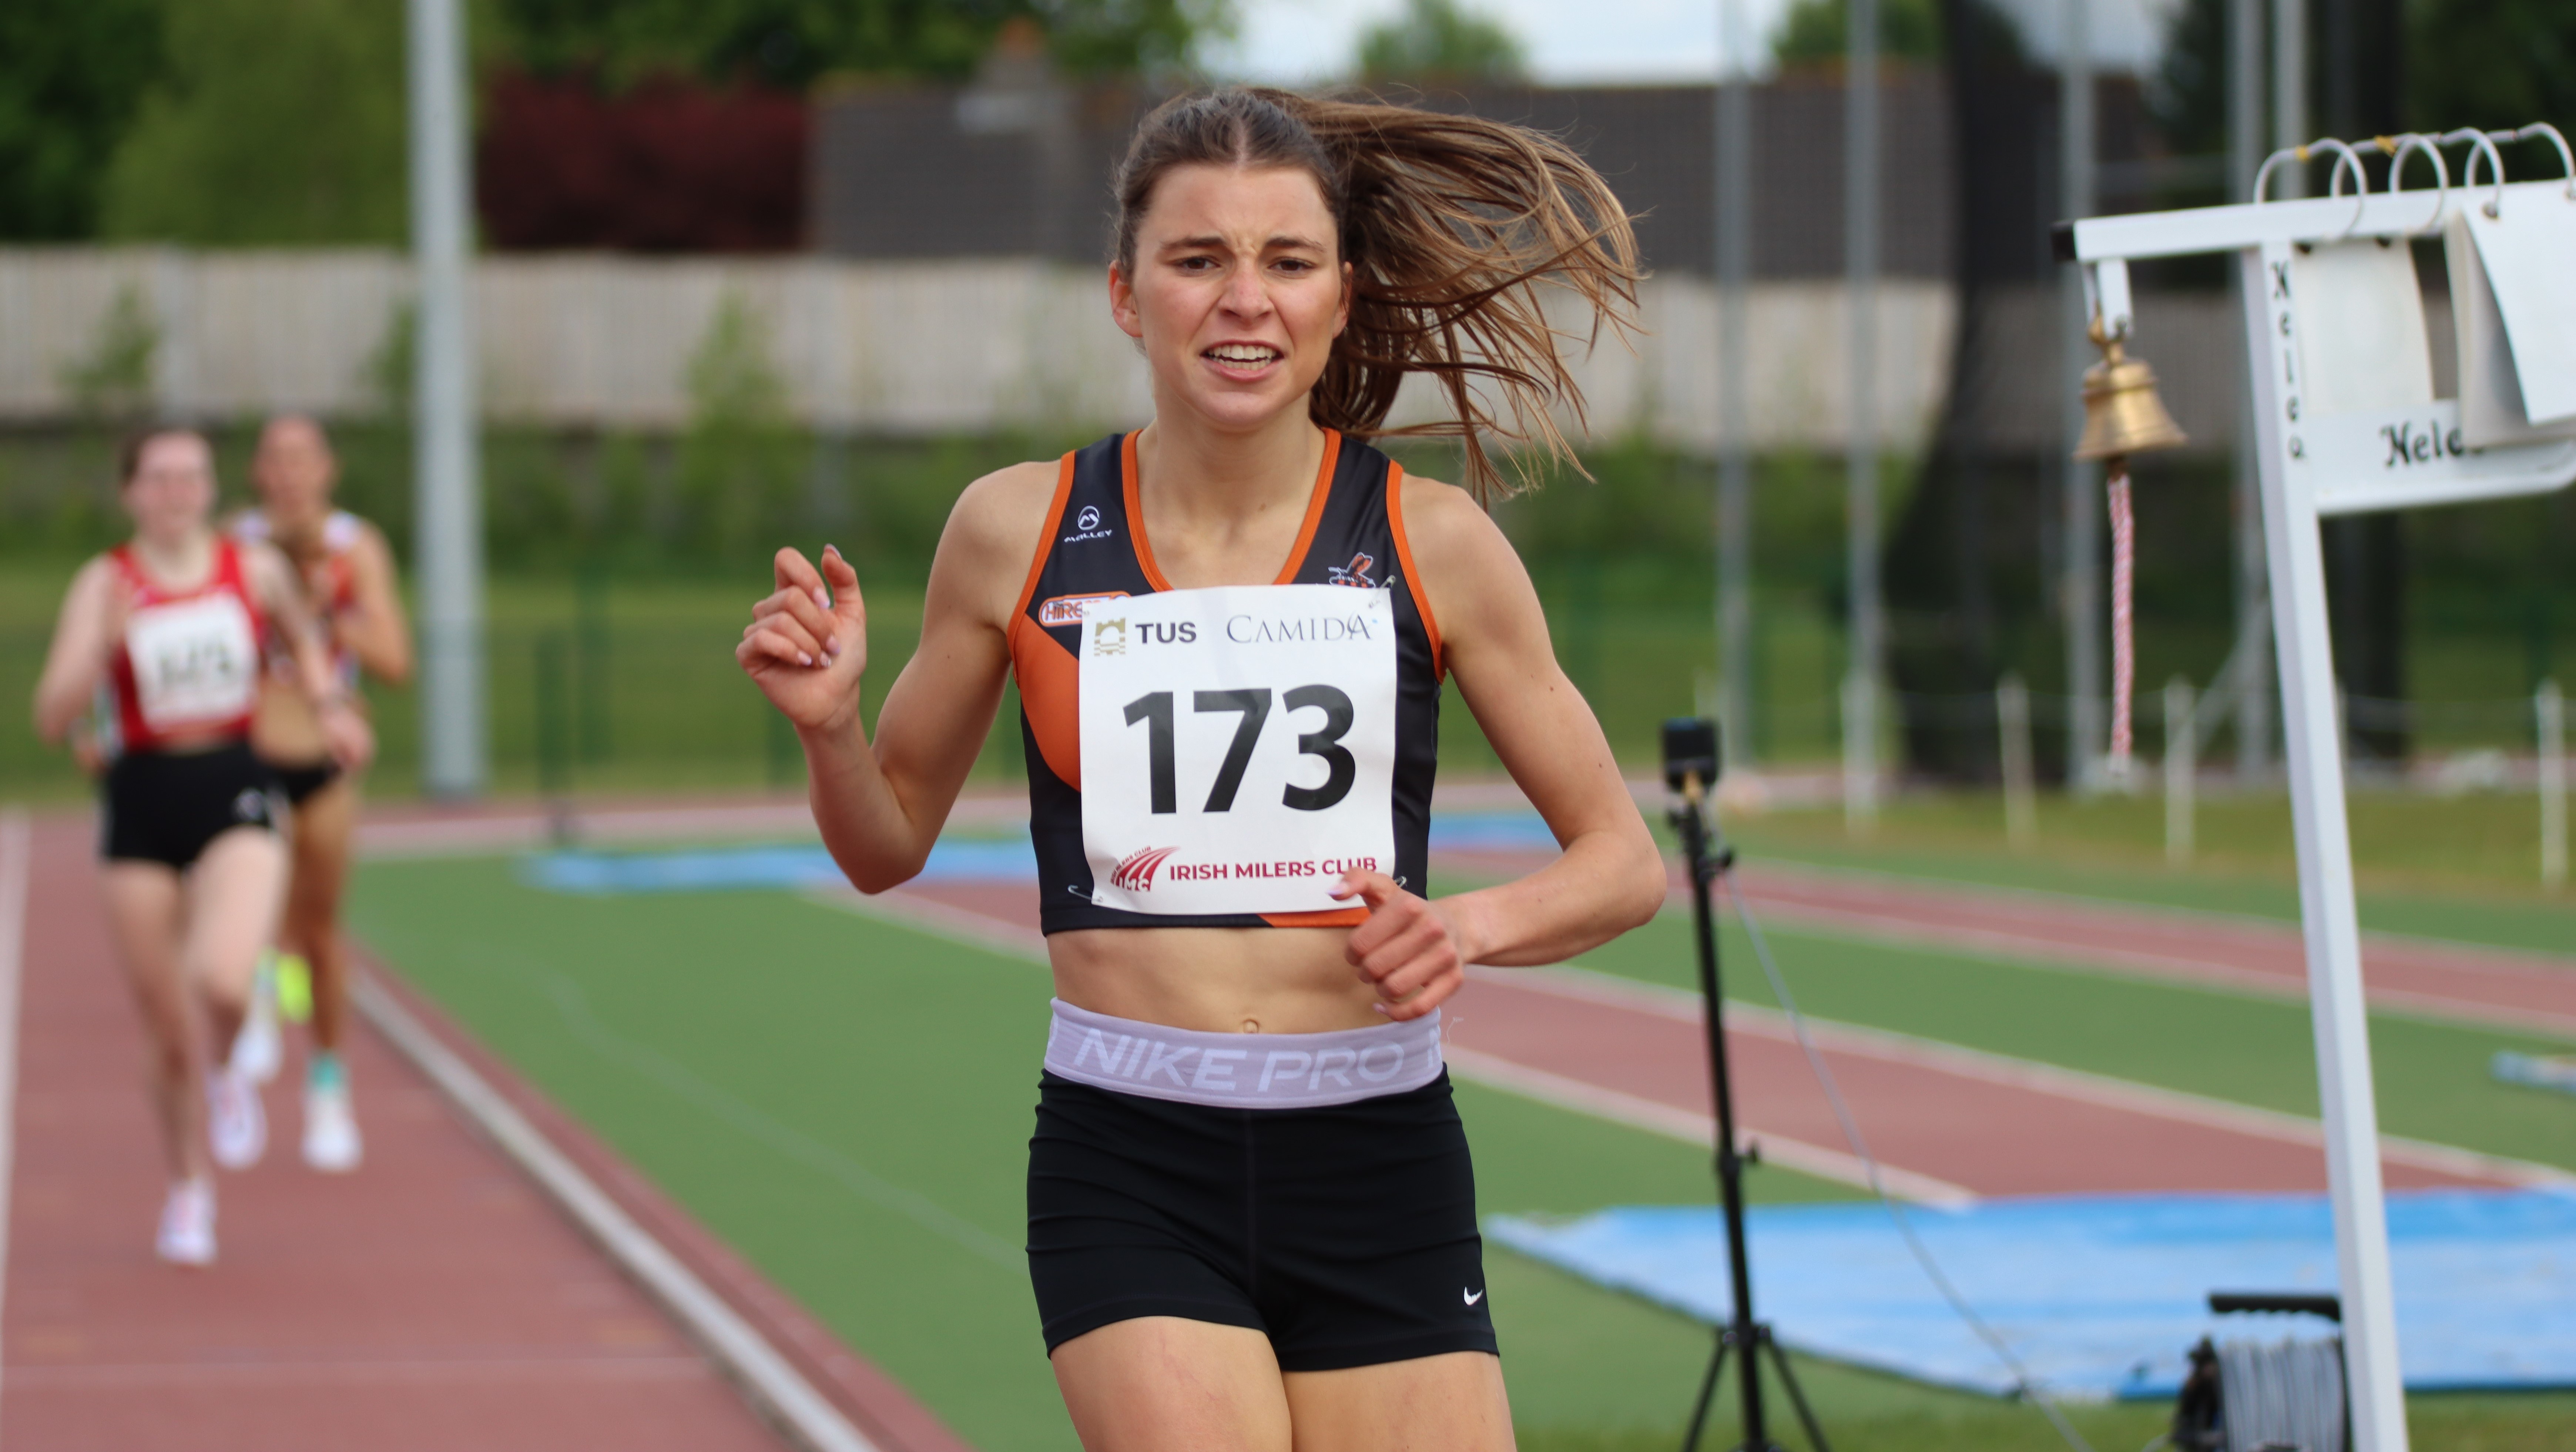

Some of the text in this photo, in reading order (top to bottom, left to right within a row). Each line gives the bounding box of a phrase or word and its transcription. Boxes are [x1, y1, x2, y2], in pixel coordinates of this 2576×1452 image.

[2380, 420, 2483, 467] Nelc
[1135, 621, 1197, 644] TUS
[1123, 684, 1356, 814] 173
[1118, 875, 1150, 892] IMC
[1170, 864, 1228, 881] IRISH
[1235, 860, 1316, 879] MILERS
[1074, 1028, 1248, 1091] NIKE
[1258, 1041, 1405, 1092] PRO
